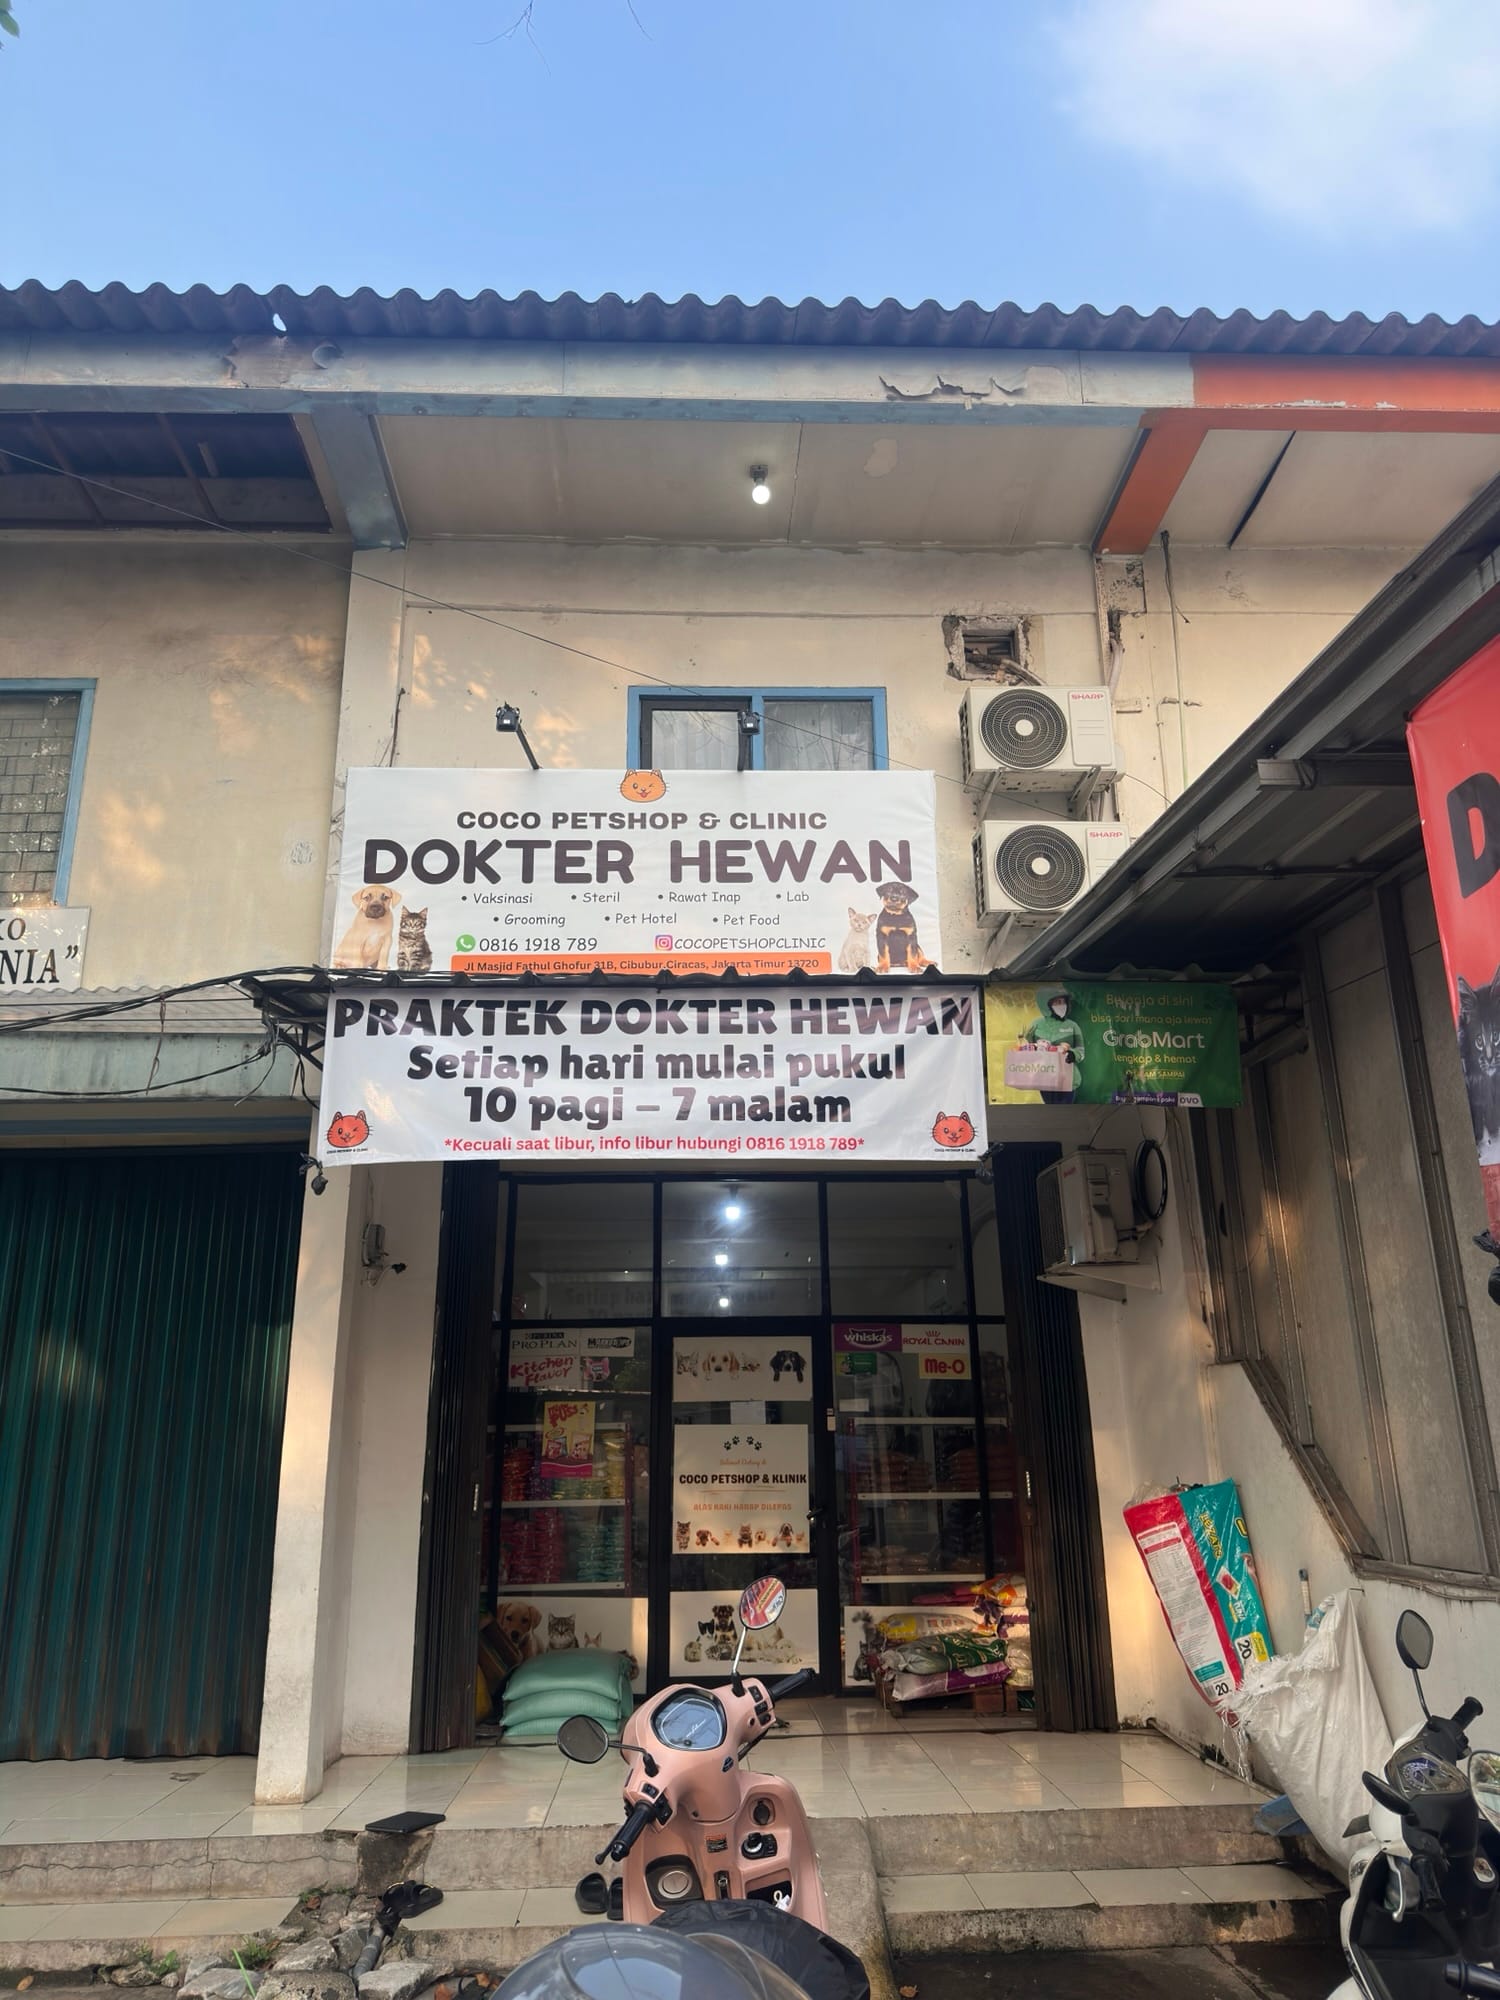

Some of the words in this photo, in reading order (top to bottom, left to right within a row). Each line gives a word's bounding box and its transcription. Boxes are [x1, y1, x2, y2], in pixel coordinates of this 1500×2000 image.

[457, 811, 541, 830] COCO
[552, 812, 688, 830] PETSHOP
[699, 812, 721, 830] &
[729, 812, 828, 830] CLINIC
[363, 839, 635, 885] DOKTER
[670, 839, 913, 883] HEWAN
[473, 893, 533, 904] Vaksinasi
[583, 892, 620, 903] Steril
[669, 892, 708, 902] Rawat
[712, 891, 741, 905] Inap
[787, 891, 809, 902] Lab
[504, 914, 566, 928] Grooming
[615, 914, 636, 925] Pet
[641, 913, 677, 924] Hotel
[723, 914, 744, 926] Pet
[749, 914, 780, 926] Food
[479, 938, 518, 952] 0816
[525, 938, 560, 951] 1918
[566, 937, 598, 951] 789
[674, 938, 826, 951] COCOPETSHOPCLINIC
[463, 961, 475, 972] Jl
[477, 961, 513, 973] Masjid
[515, 960, 551, 971] Fathul
[552, 960, 592, 971] Ghofur
[594, 960, 618, 972] 31B,
[711, 959, 752, 970] Jakarta
[754, 959, 785, 969] Timur
[787, 959, 819, 969] 13720
[333, 998, 568, 1038] PRAKTEK
[580, 998, 777, 1036] DOKTER
[790, 997, 974, 1035] HEWAN
[1103, 1029, 1206, 1049] GrabMart
[407, 1045, 549, 1087] Setiap
[560, 1044, 644, 1080] hari
[655, 1044, 775, 1079] mulai
[786, 1044, 906, 1086] pukul
[1113, 1053, 1152, 1066] lengkap
[1154, 1055, 1162, 1064] &
[1163, 1053, 1197, 1064] hemat
[464, 1086, 517, 1123] 10
[528, 1086, 624, 1131] pagi
[672, 1086, 697, 1121] 7
[707, 1086, 852, 1123] malam
[515, 1138, 552, 1151] saat
[554, 1137, 596, 1152] libur,
[599, 1136, 631, 1150] info
[635, 1136, 674, 1150] libur
[676, 1136, 742, 1153] hubungi
[746, 1137, 785, 1150] 0816
[789, 1137, 826, 1150] 1918
[844, 1332, 893, 1343] whiskas
[903, 1337, 932, 1346] ROYAL
[934, 1337, 965, 1346] CANIN
[925, 1358, 965, 1374] Me-O
[680, 1474, 708, 1484] COCO
[711, 1474, 760, 1484] PETSHOP
[762, 1474, 769, 1483] &
[772, 1474, 807, 1483] KLINIK
[1237, 1639, 1252, 1660] 20
[1215, 1681, 1229, 1697] 20
